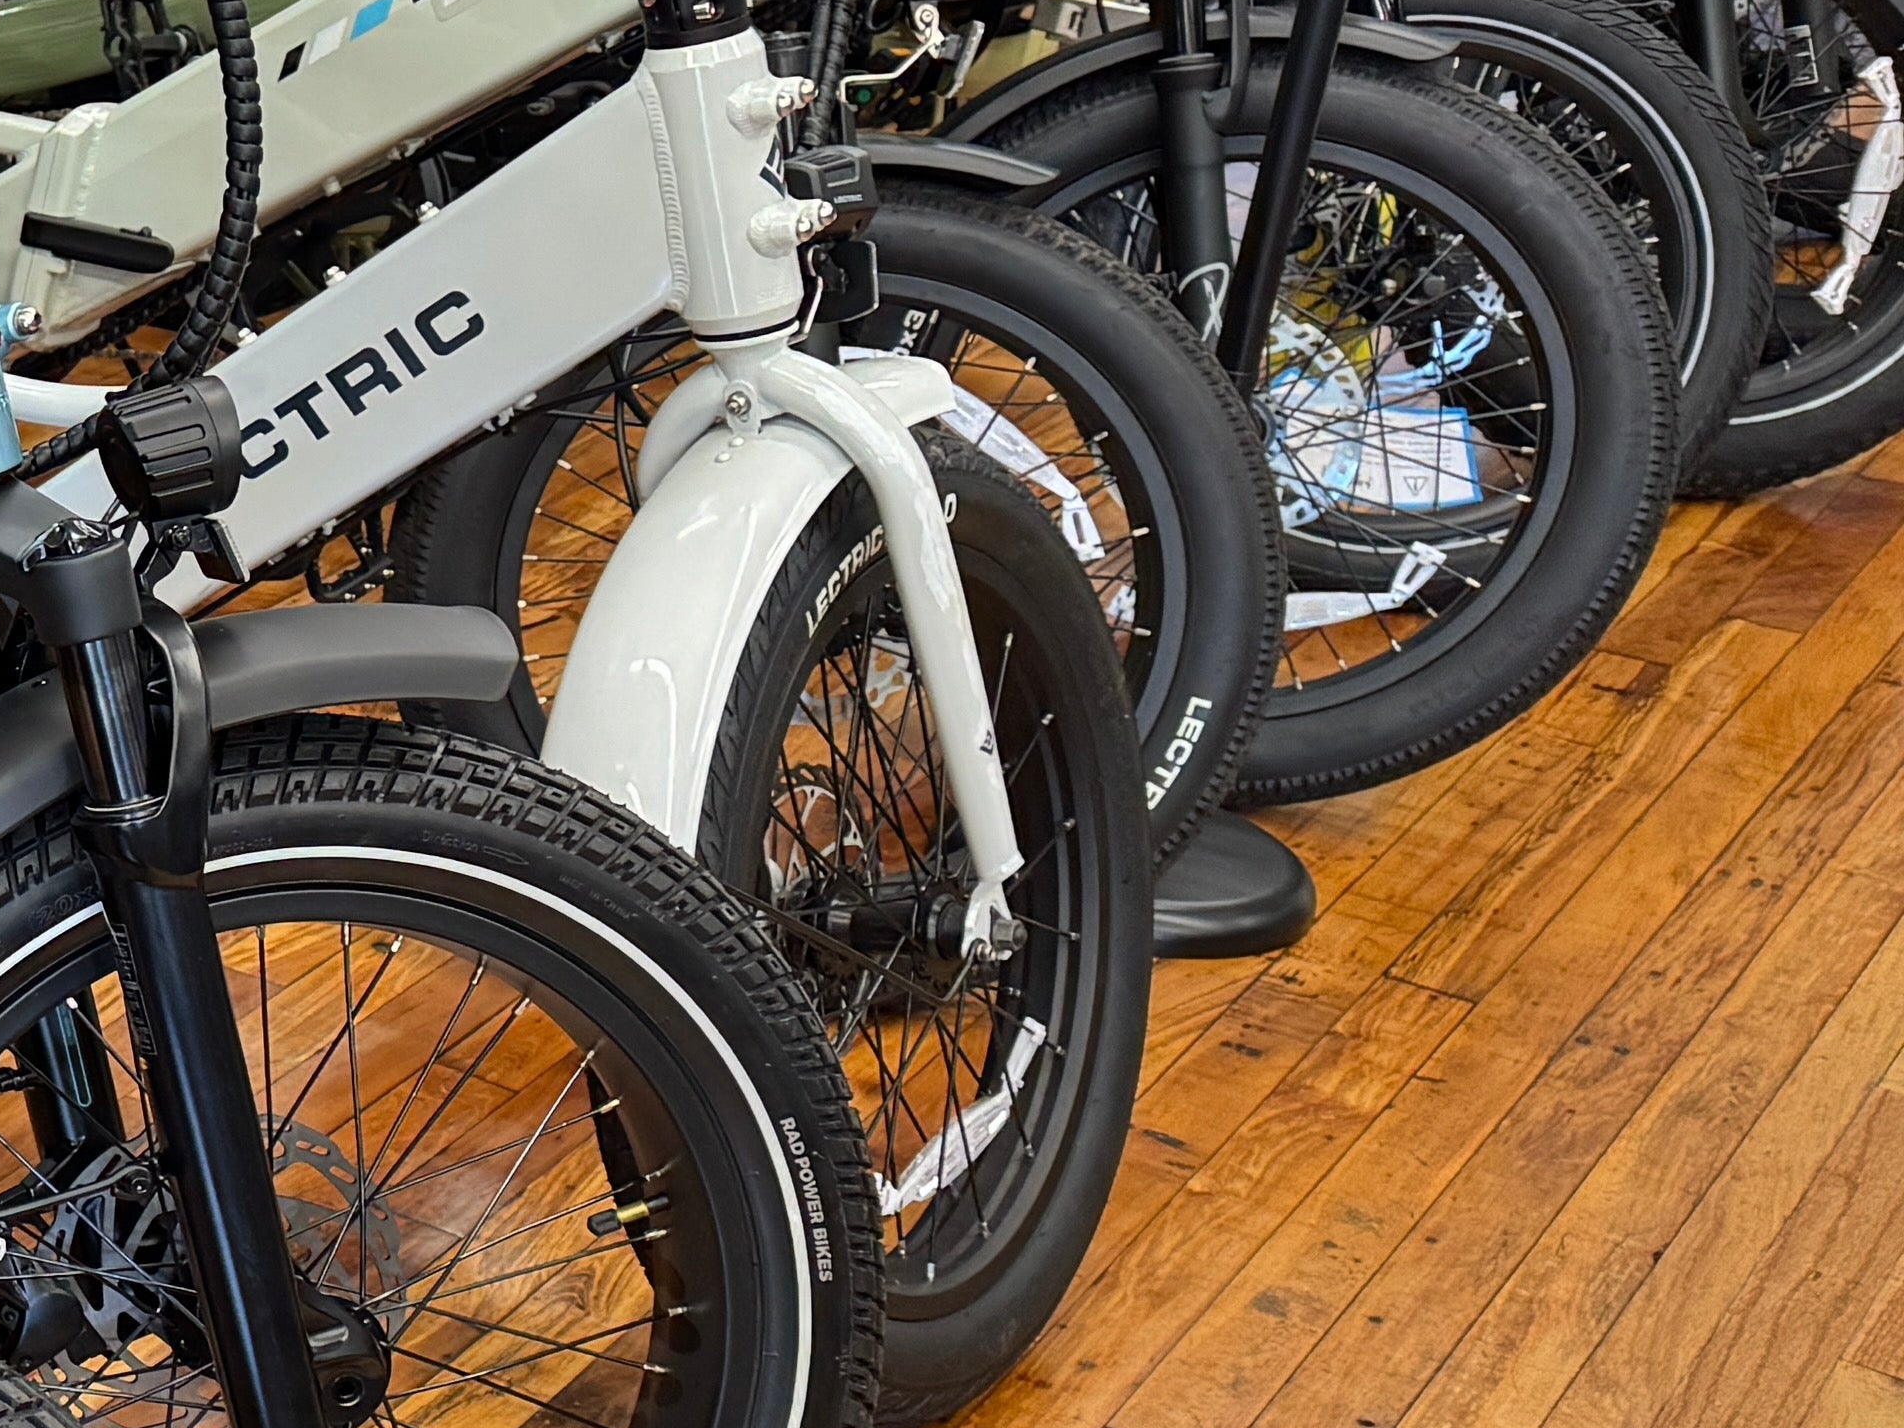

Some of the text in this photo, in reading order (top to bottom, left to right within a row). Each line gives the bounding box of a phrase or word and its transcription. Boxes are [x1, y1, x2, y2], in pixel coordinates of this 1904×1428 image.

[240, 289, 485, 480] CTRIC
[804, 525, 885, 639] LECTRIC
[779, 1116, 833, 1283] RAD POWER BIKES
